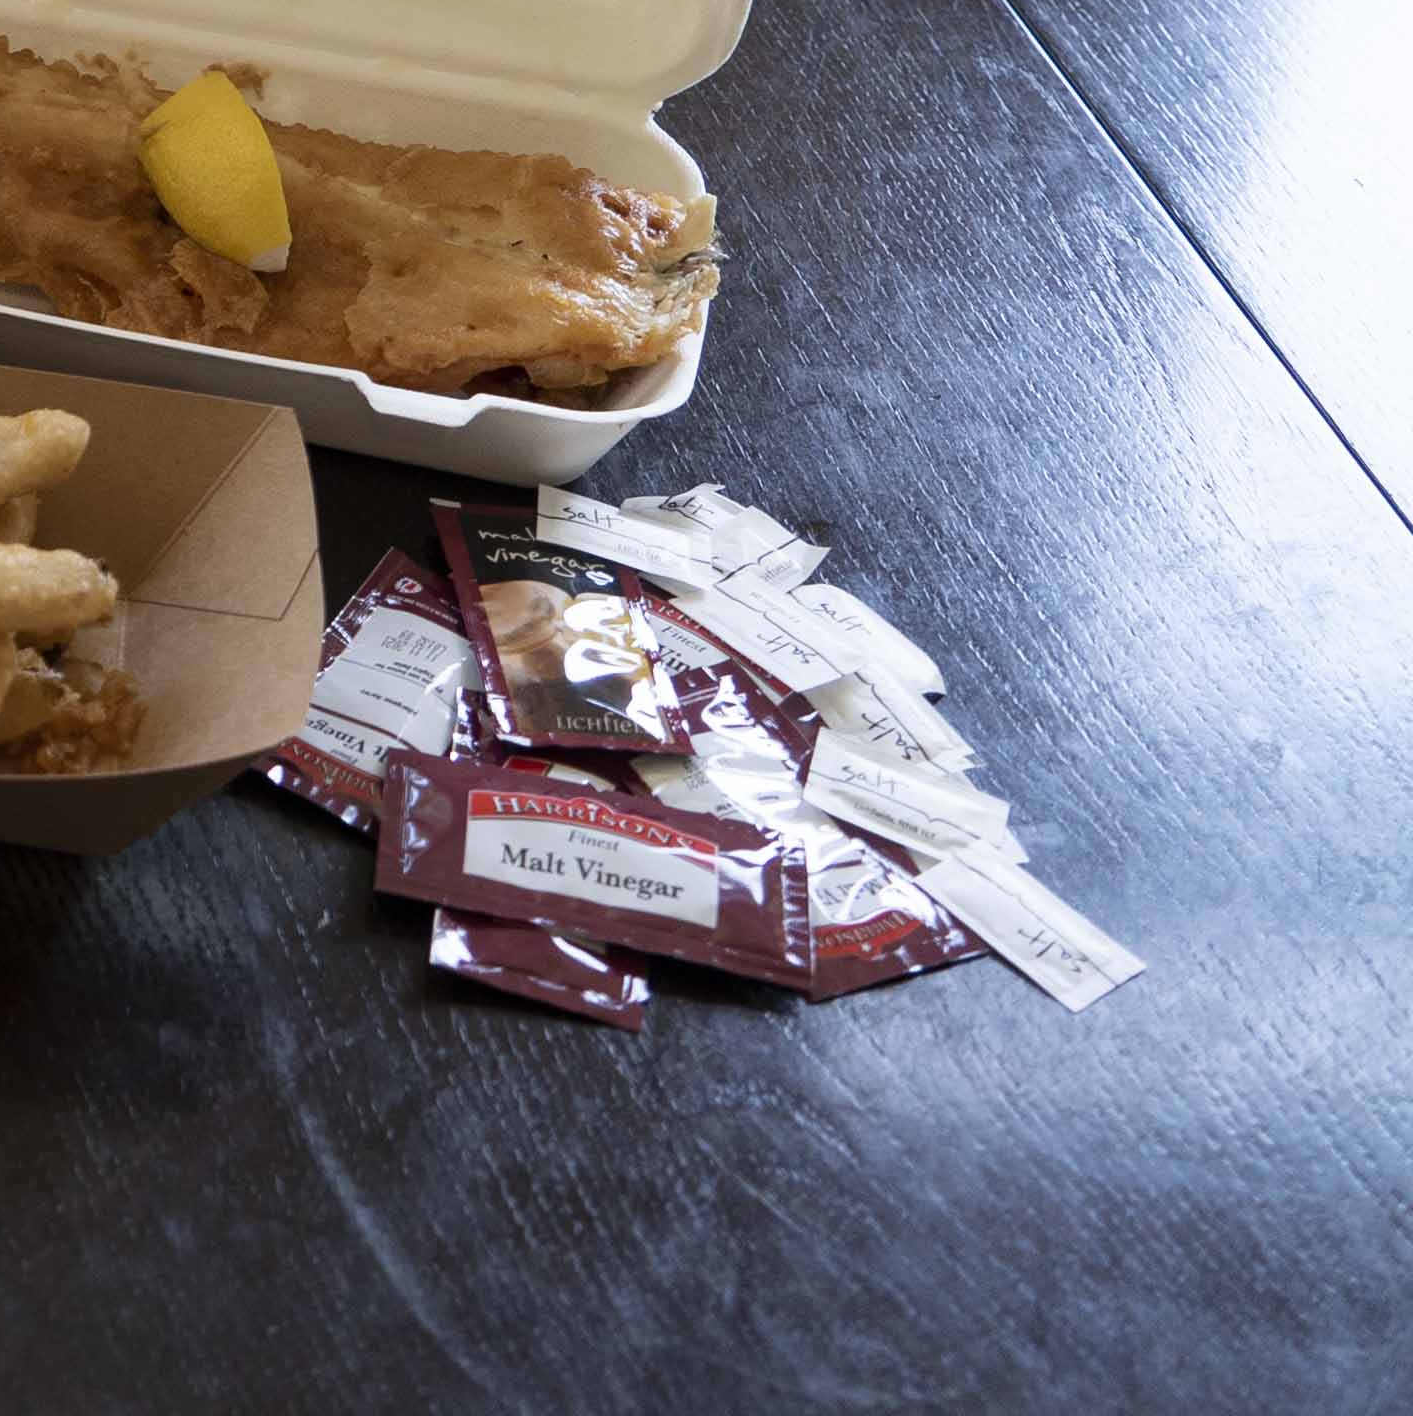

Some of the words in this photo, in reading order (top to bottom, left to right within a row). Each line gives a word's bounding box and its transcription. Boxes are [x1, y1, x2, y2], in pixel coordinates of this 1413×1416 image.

[562, 507, 623, 529] salt
[478, 527, 537, 542] mal
[486, 548, 607, 578] vinegar
[820, 603, 872, 633] salt
[757, 632, 818, 665] salt
[861, 712, 920, 761] salt
[841, 765, 910, 795] salt
[492, 795, 694, 849] HARRISONS
[568, 829, 620, 853] Finest
[501, 843, 566, 876] Malt
[574, 857, 685, 901] Vinegar
[1017, 929, 1090, 974] salt
